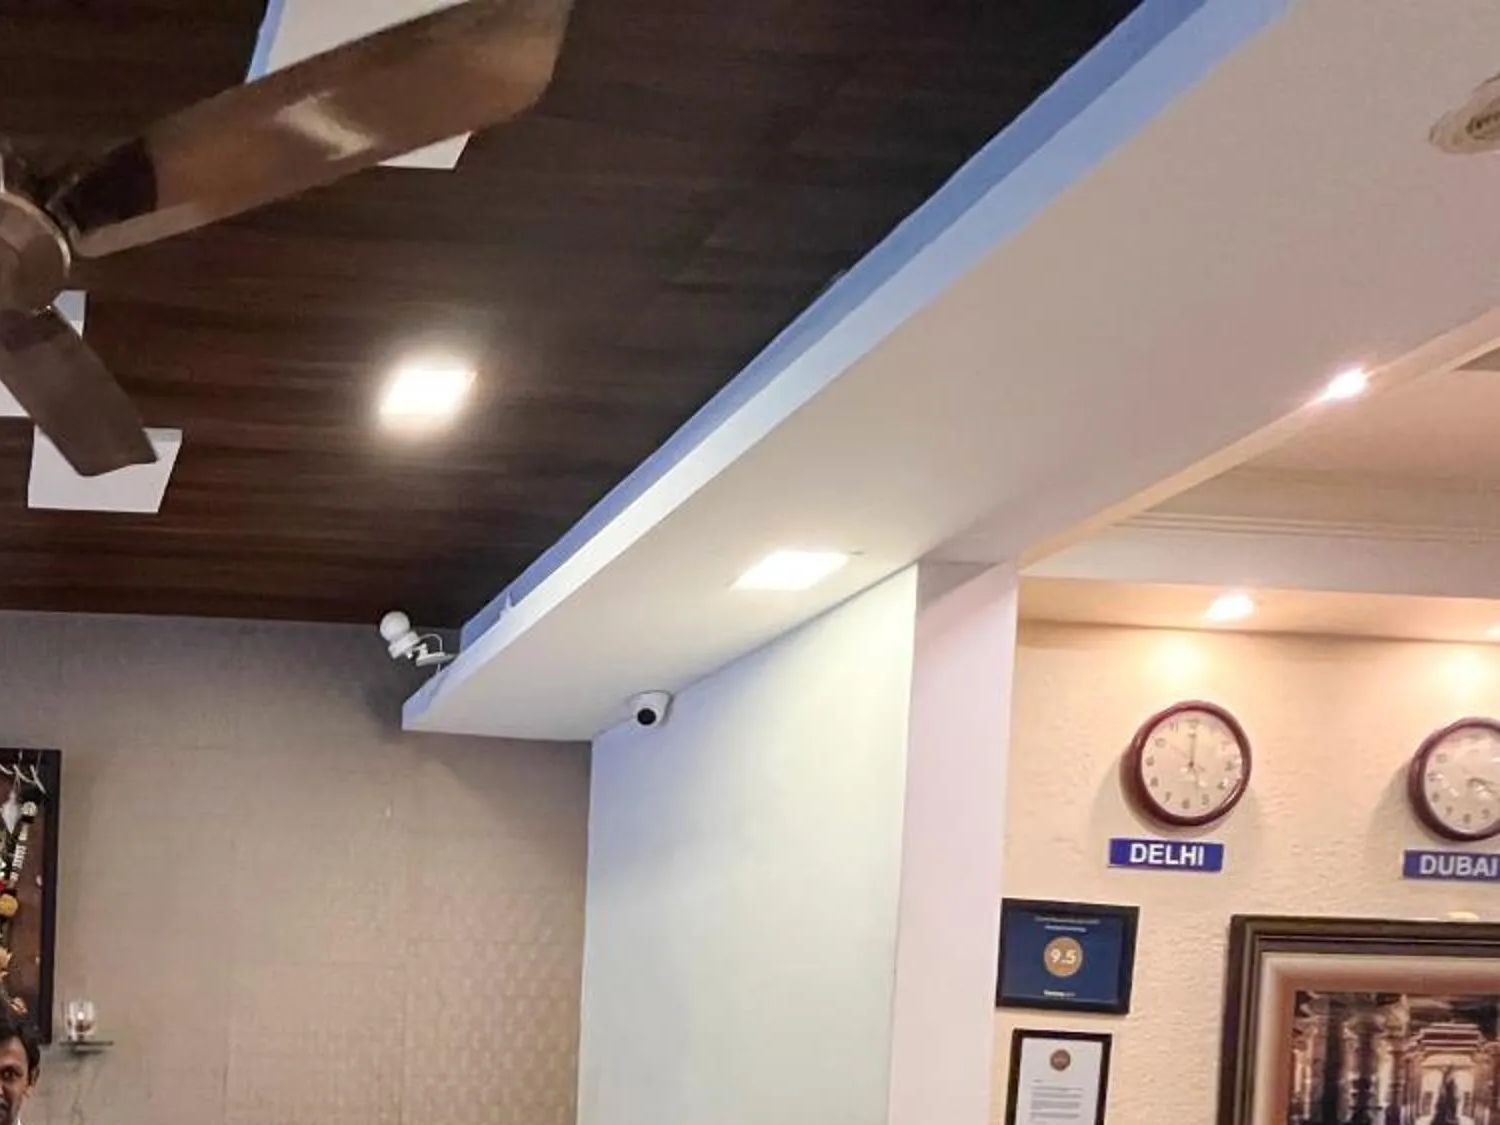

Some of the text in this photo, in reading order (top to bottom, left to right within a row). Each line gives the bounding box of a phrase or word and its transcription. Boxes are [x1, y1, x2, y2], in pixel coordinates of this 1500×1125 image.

[1129, 843, 1205, 867] DELHI
[1418, 854, 1498, 877] DUBAI
[1051, 948, 1077, 965] 9.5
